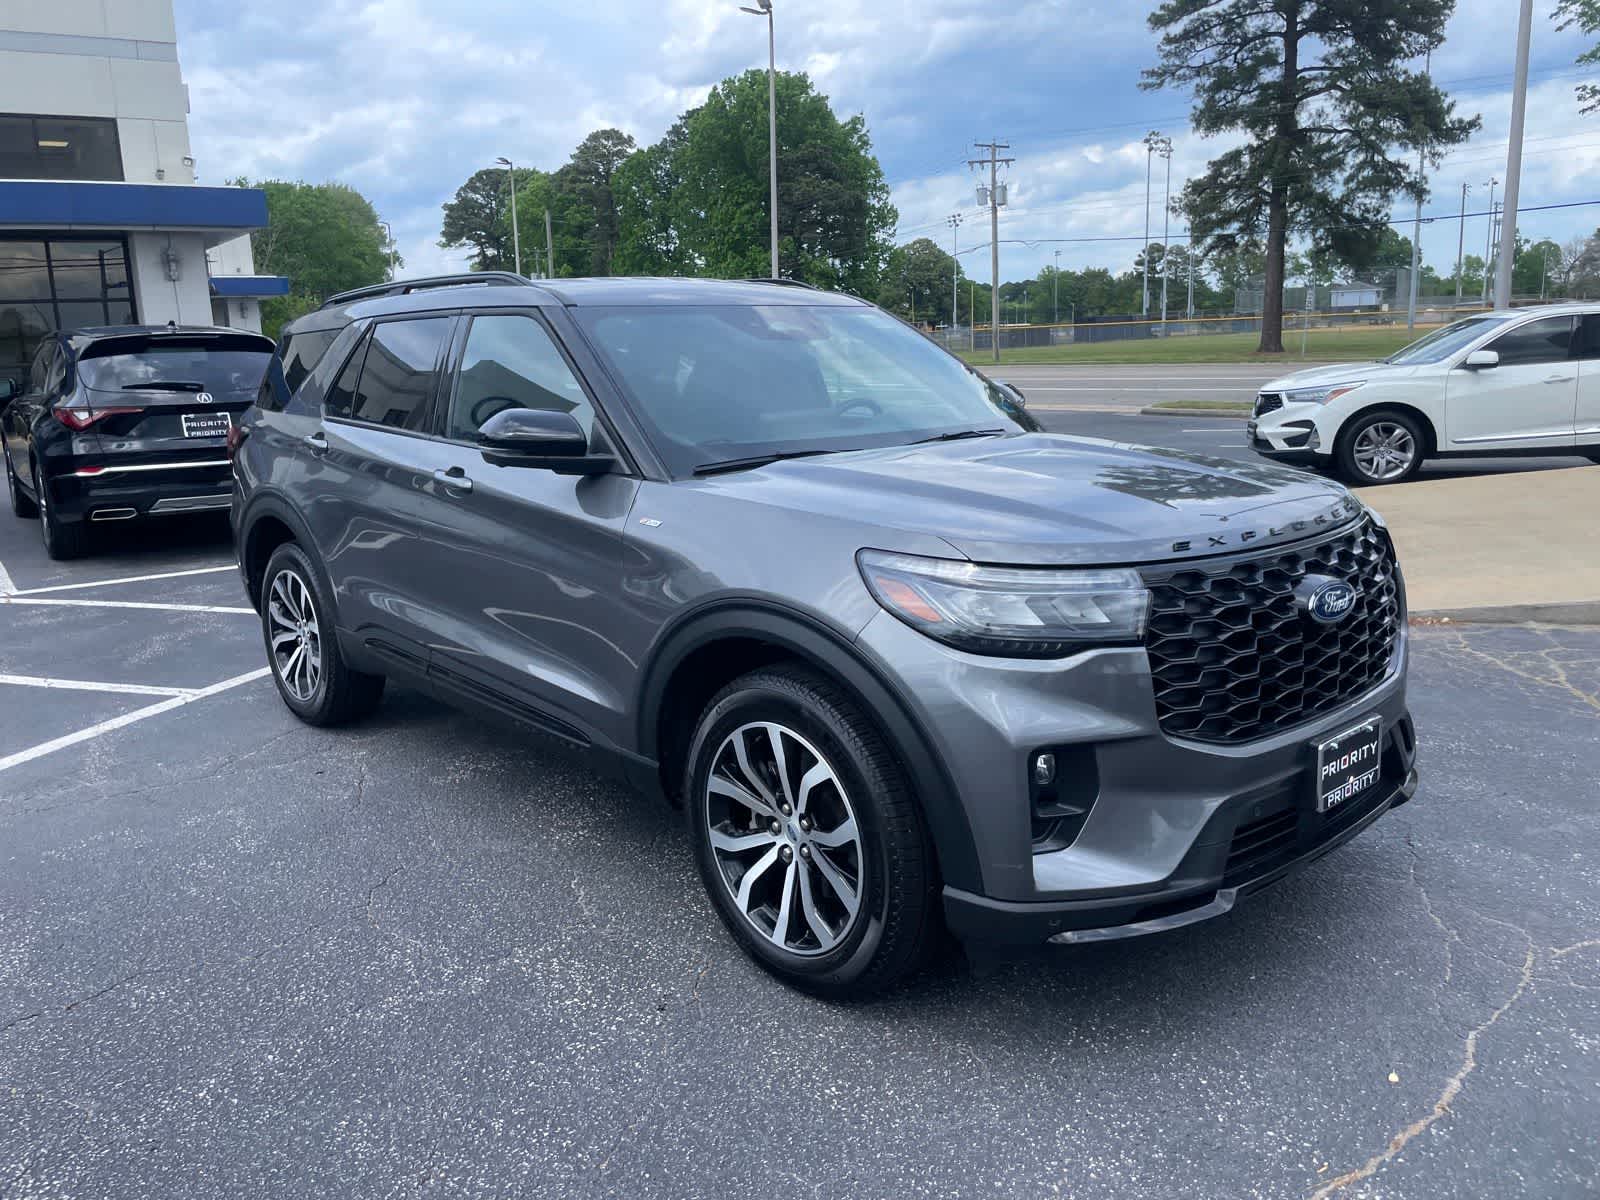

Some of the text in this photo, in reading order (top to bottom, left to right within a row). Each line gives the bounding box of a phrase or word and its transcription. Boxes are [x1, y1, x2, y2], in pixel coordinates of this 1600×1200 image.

[1325, 589, 1349, 613] Ford
[1321, 740, 1378, 781] PRIORITY
[1327, 771, 1375, 808] PRIORITY
